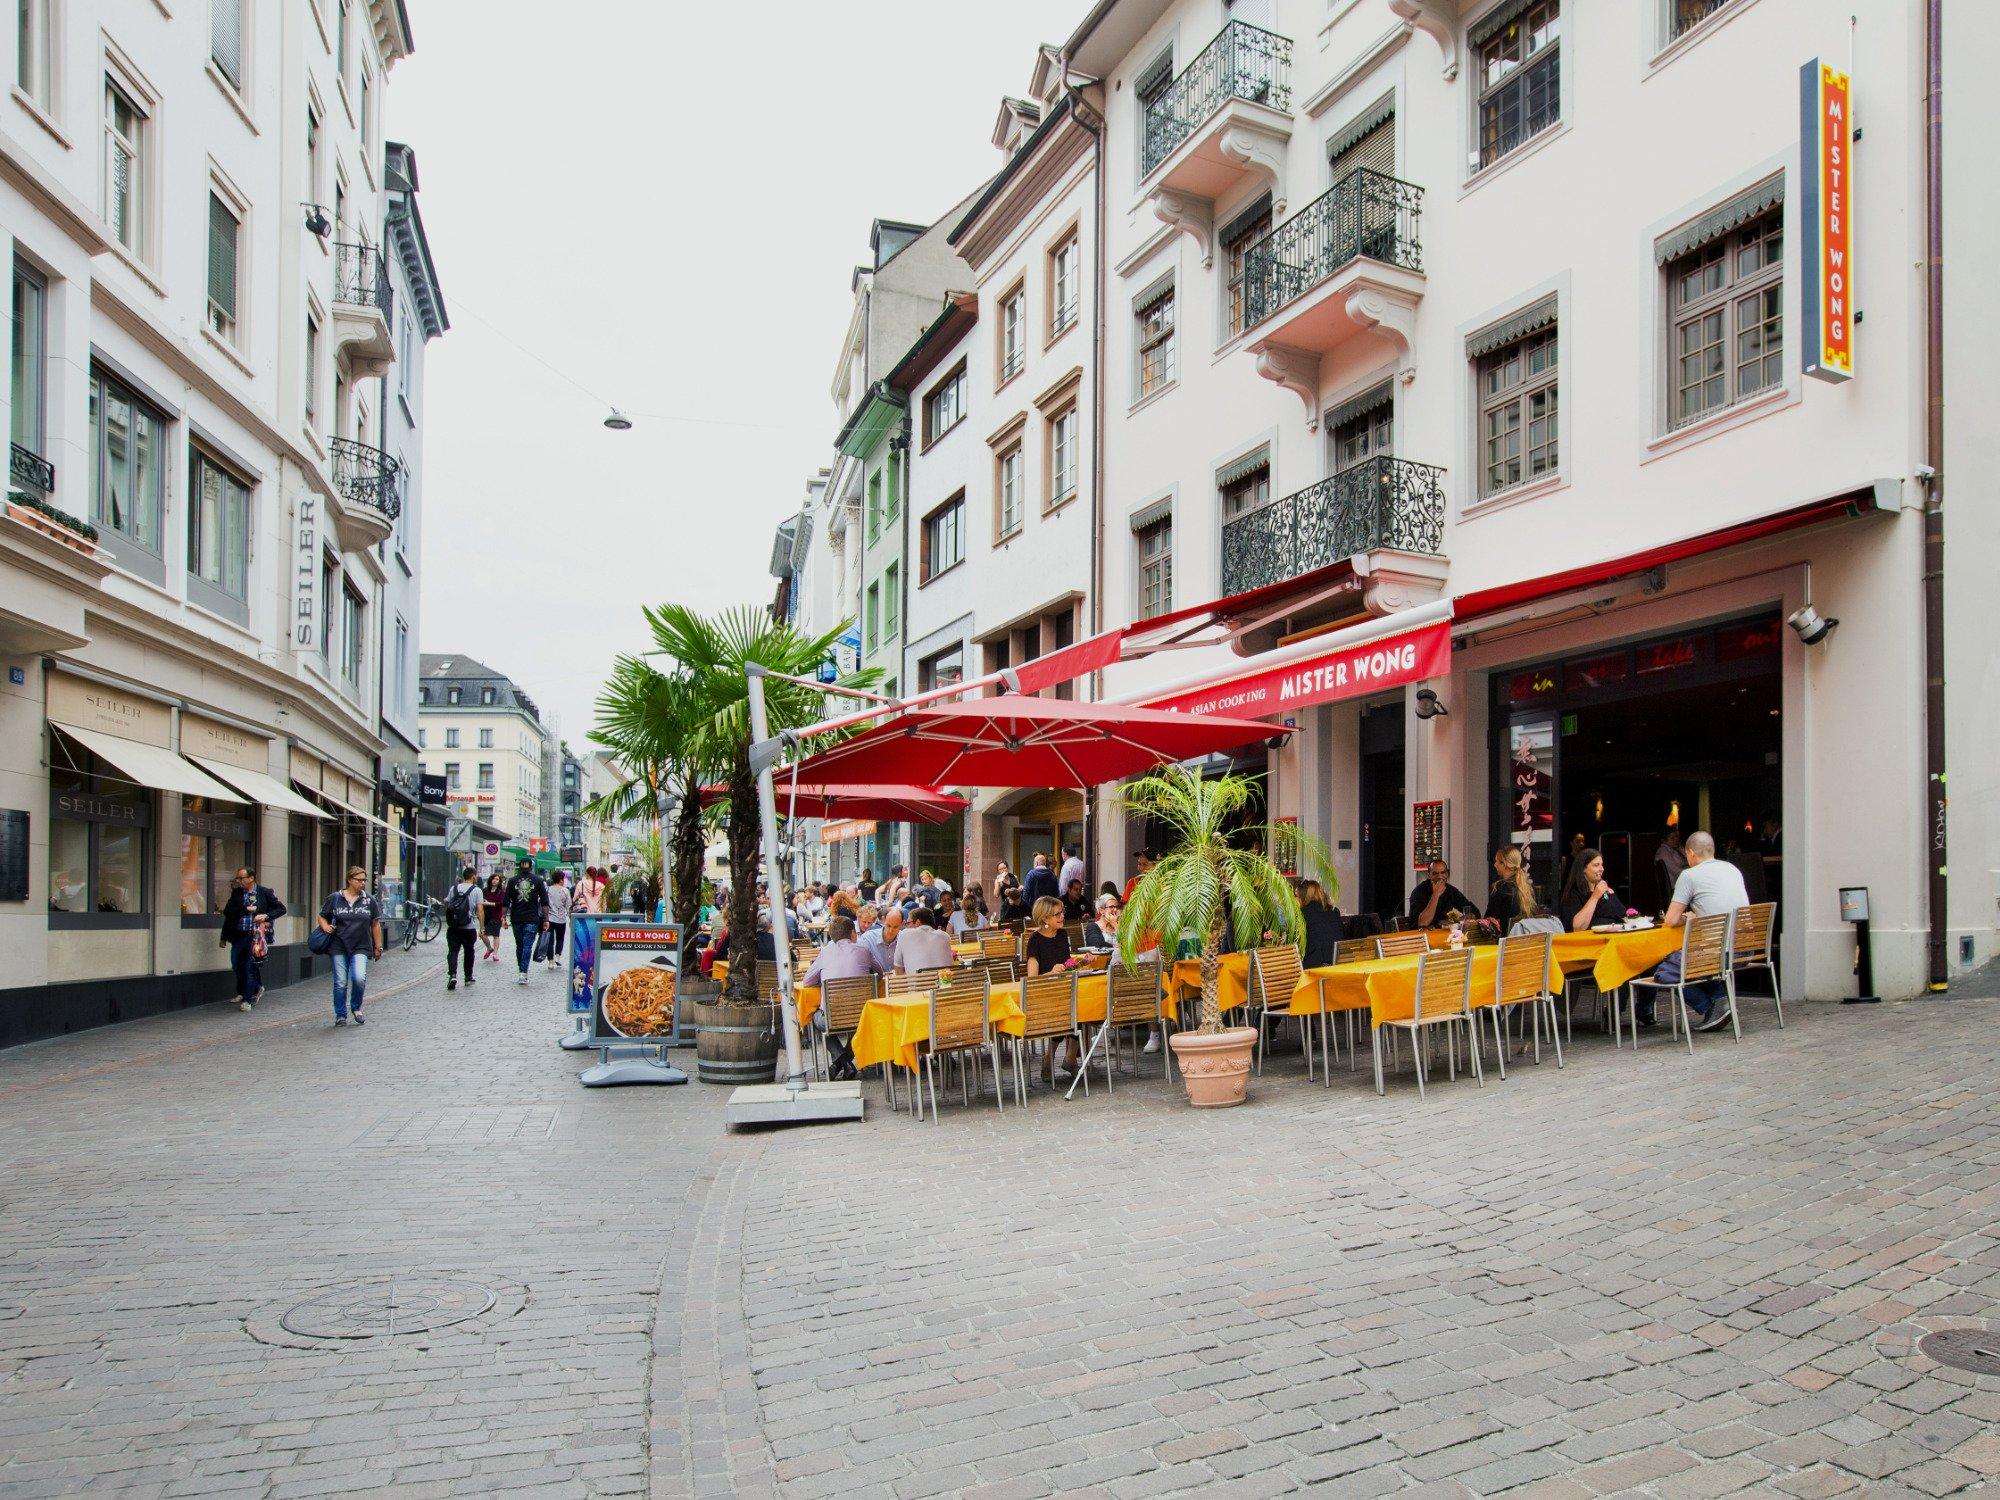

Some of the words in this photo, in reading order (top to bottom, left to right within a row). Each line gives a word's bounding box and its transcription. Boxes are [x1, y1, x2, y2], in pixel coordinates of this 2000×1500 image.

[1829, 99, 1843, 235] MISTER
[1829, 247, 1843, 341] WONG
[298, 499, 315, 645] SEILER
[843, 649, 851, 668] BAR
[1190, 699, 1217, 716] ASIAN
[1218, 688, 1267, 710] COOKING
[1279, 661, 1348, 701] MISTER
[1353, 643, 1416, 682] WONG
[86, 694, 142, 718] SEILER
[424, 786, 445, 798] Sony
[59, 796, 136, 820] SEILER
[186, 815, 242, 835] SEILER
[608, 931, 641, 939] MISTER
[644, 932, 671, 940] WONG
